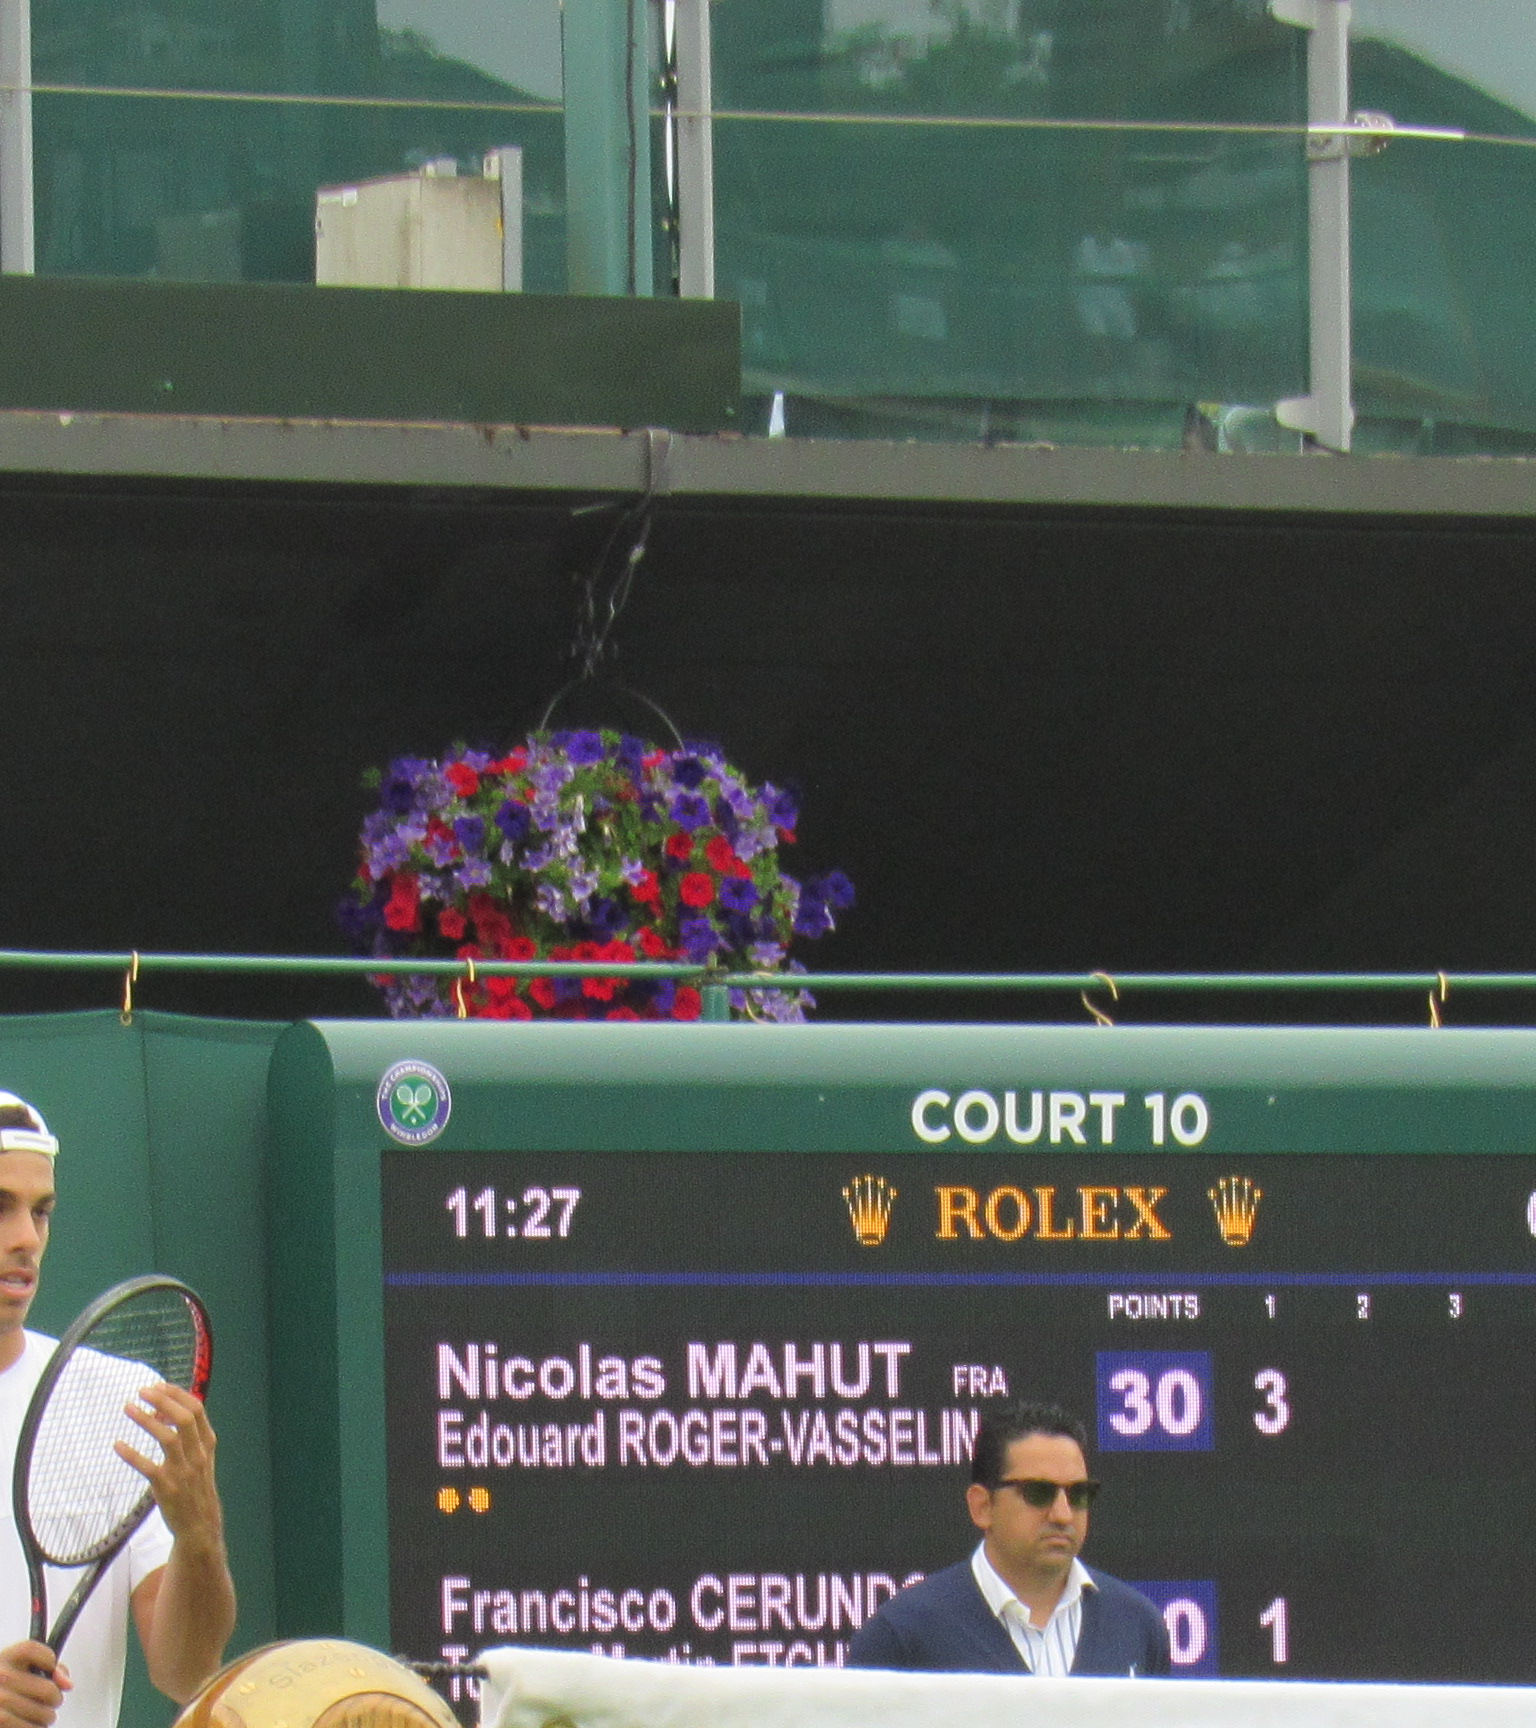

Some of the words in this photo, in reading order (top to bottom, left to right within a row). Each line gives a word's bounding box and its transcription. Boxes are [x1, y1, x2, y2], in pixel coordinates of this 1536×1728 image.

[911, 1089, 1126, 1145] COURT
[1144, 1092, 1209, 1146] 10
[446, 1186, 582, 1239] 11:27
[934, 1185, 1172, 1242] ROLEX
[1107, 1293, 1200, 1320] POINTS
[1264, 1294, 1276, 1319] 1
[1356, 1293, 1370, 1320] 2
[1448, 1293, 1462, 1319] 3
[437, 1342, 667, 1400] Nicolas
[687, 1341, 912, 1399] MAHUT
[952, 1364, 1008, 1397] FRA
[1109, 1369, 1201, 1436] 30
[1253, 1368, 1290, 1435] 3
[437, 1410, 606, 1468] Edouard
[618, 1408, 980, 1467] ROGER-VASSELIN
[441, 1575, 677, 1634] Francisco
[689, 1571, 926, 1632] CERUND
[1163, 1599, 1206, 1665] 0
[1259, 1597, 1288, 1664] 1
